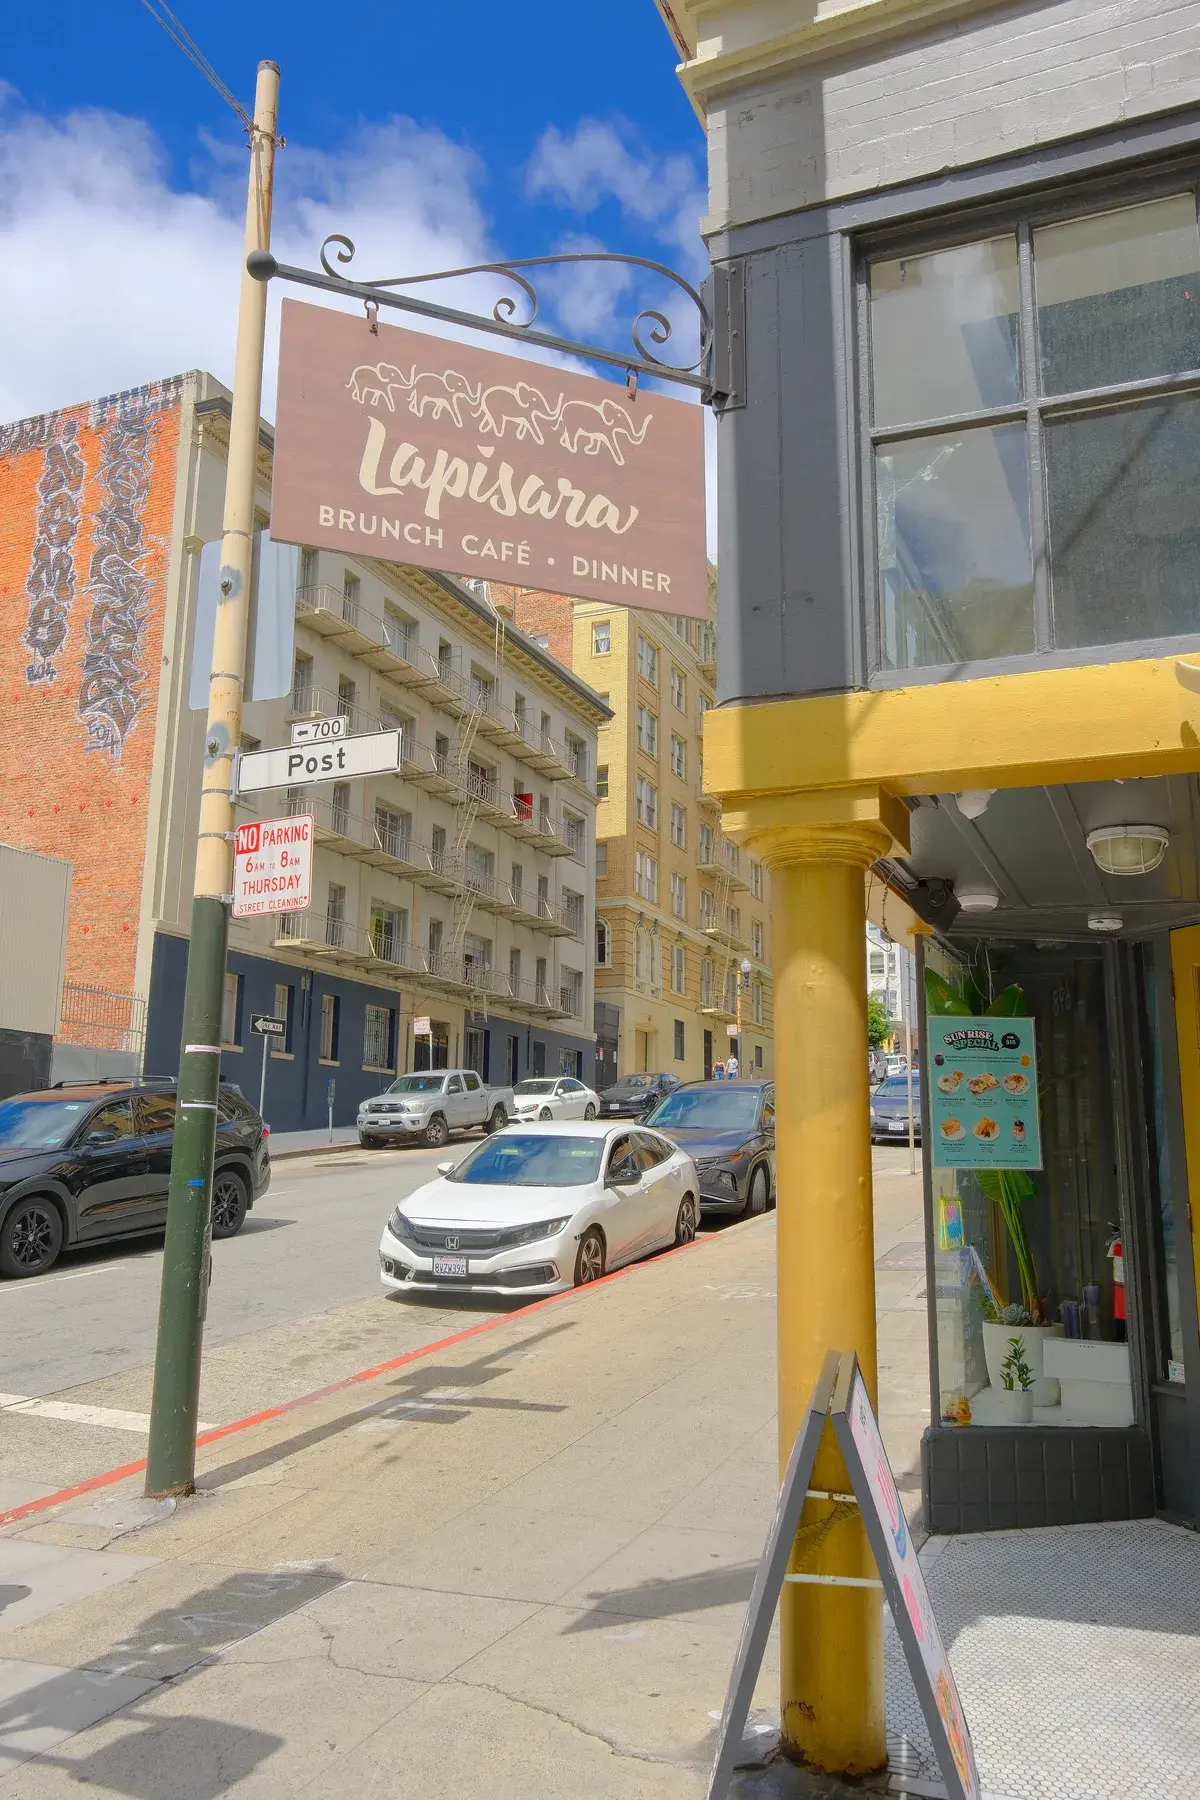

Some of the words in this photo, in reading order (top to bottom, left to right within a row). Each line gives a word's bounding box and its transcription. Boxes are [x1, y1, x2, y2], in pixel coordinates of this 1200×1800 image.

[359, 415, 639, 534] Lapisara
[319, 505, 443, 549] BRUNCH
[461, 540, 531, 566] CAFÉ
[573, 556, 671, 594] DINNER
[312, 719, 341, 738] 700
[288, 747, 346, 777] Post
[238, 824, 259, 851] NO
[262, 823, 308, 847] PARKING
[245, 857, 264, 873] 6AM
[280, 851, 300, 867] 8AM
[242, 874, 302, 896] THURSDAY
[239, 901, 264, 914] STREET
[268, 897, 304, 910] CLEANING
[944, 1031, 965, 1044] SUN
[967, 1030, 993, 1041] RISE
[953, 1039, 999, 1051] SPECIAL
